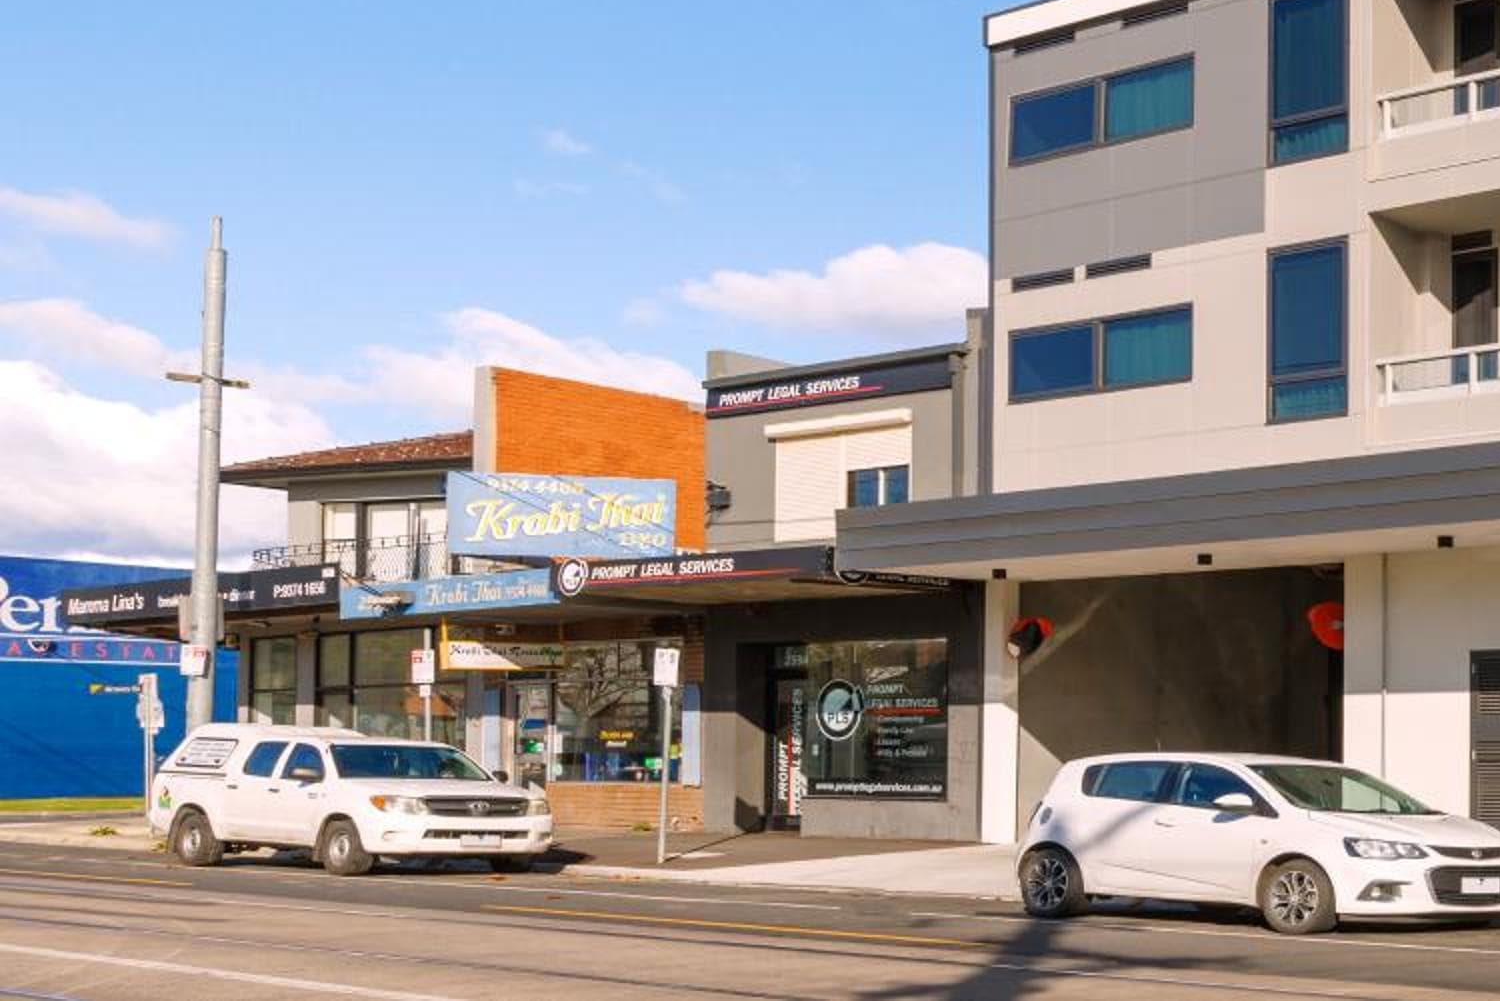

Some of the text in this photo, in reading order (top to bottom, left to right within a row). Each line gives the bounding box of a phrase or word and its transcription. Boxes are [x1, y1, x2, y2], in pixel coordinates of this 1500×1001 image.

[719, 376, 860, 406] PROMPT LEGAL SERVICES
[464, 492, 667, 542] Krabi Thai
[592, 558, 735, 579] PROMPT LEGAL SERVICES
[69, 641, 176, 659] ESTAT
[827, 712, 850, 724] PLS
[778, 742, 789, 800] PROMPT
